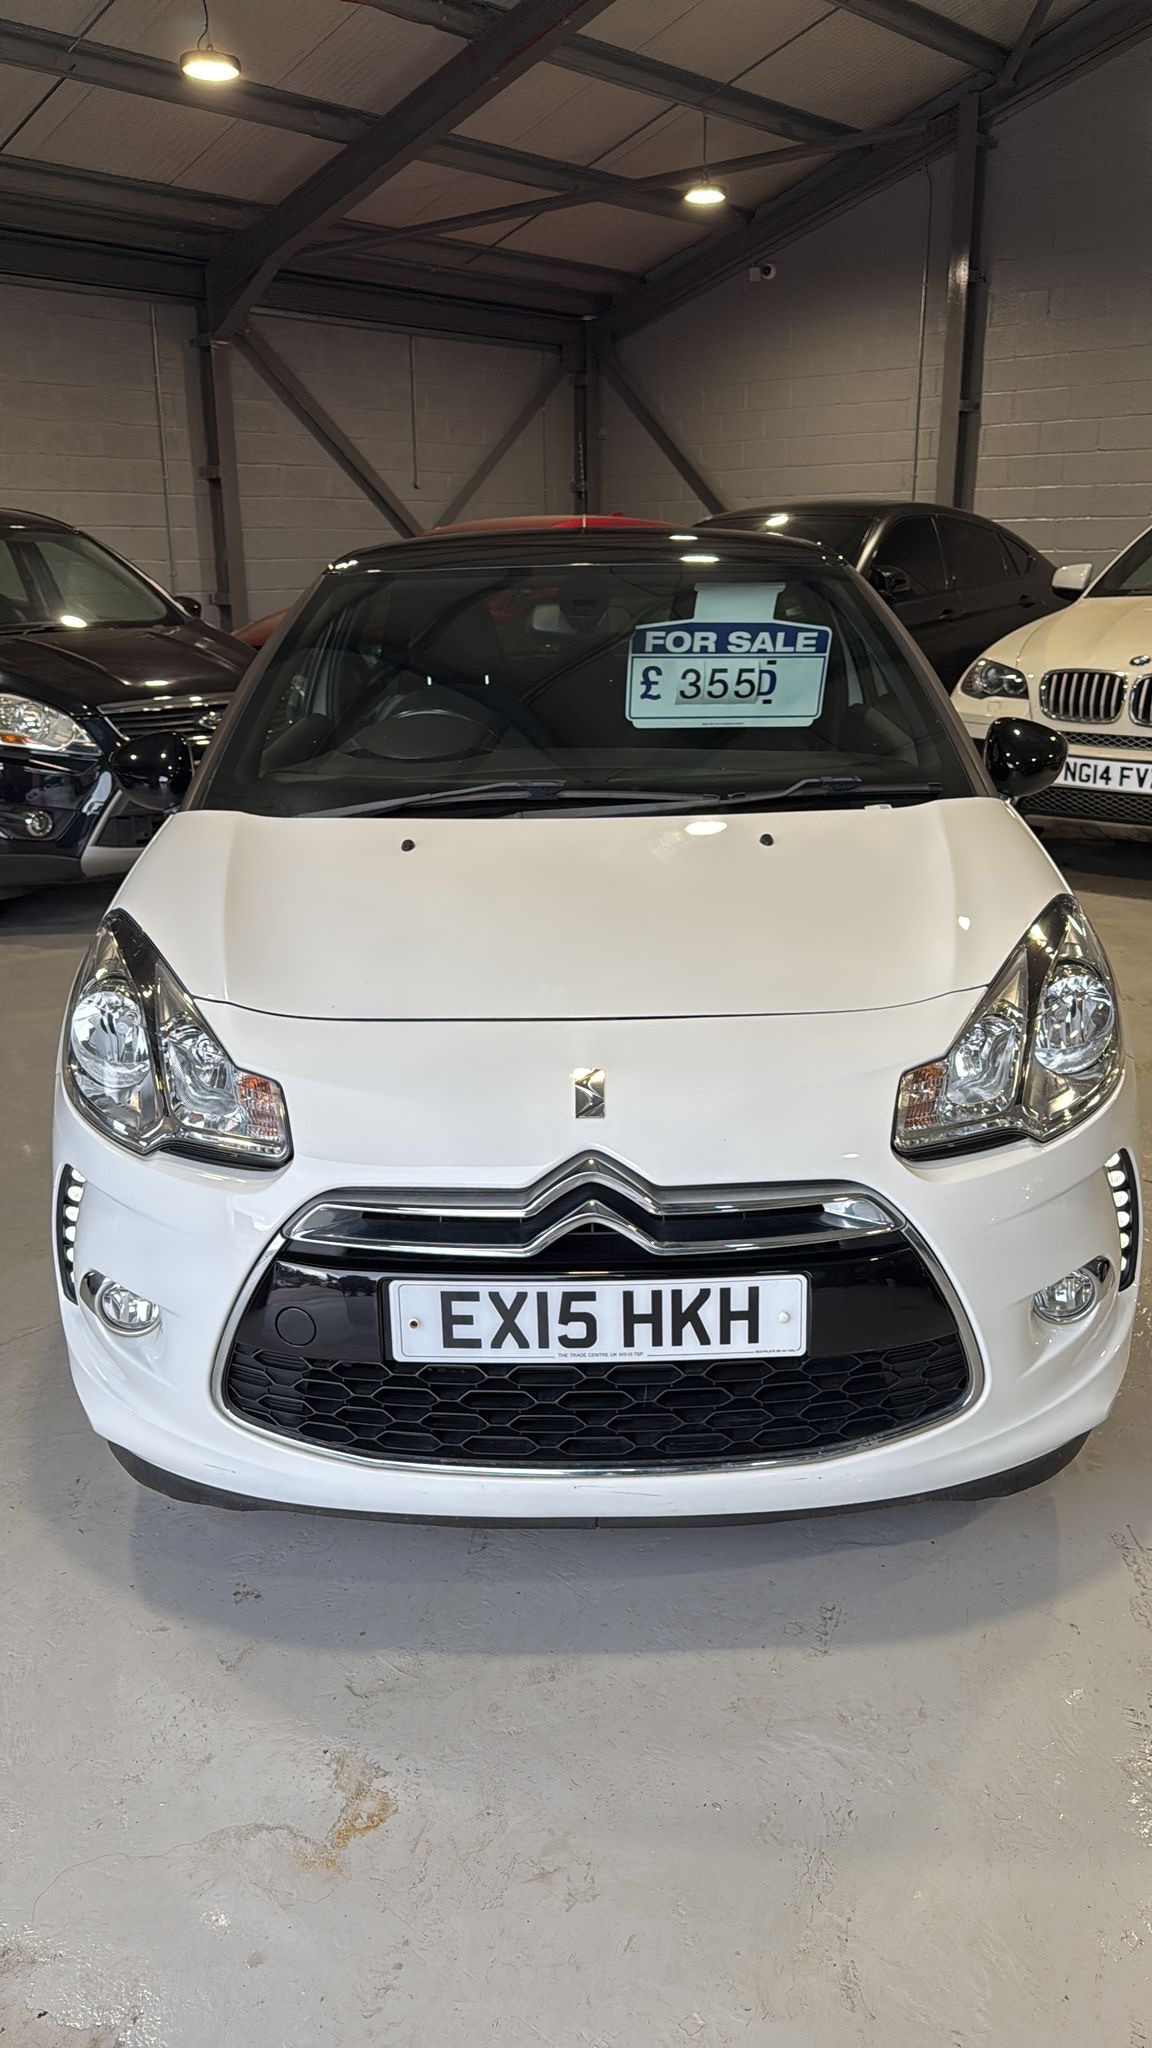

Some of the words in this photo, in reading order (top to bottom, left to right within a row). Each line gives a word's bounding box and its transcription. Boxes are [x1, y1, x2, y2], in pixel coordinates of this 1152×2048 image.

[644, 631, 718, 653] FOR
[727, 631, 819, 653] SALE
[640, 665, 663, 701] £
[1063, 761, 1112, 786] NG14
[1118, 766, 1152, 789] FV
[440, 1289, 598, 1350] EX15
[621, 1285, 761, 1348] HKH
